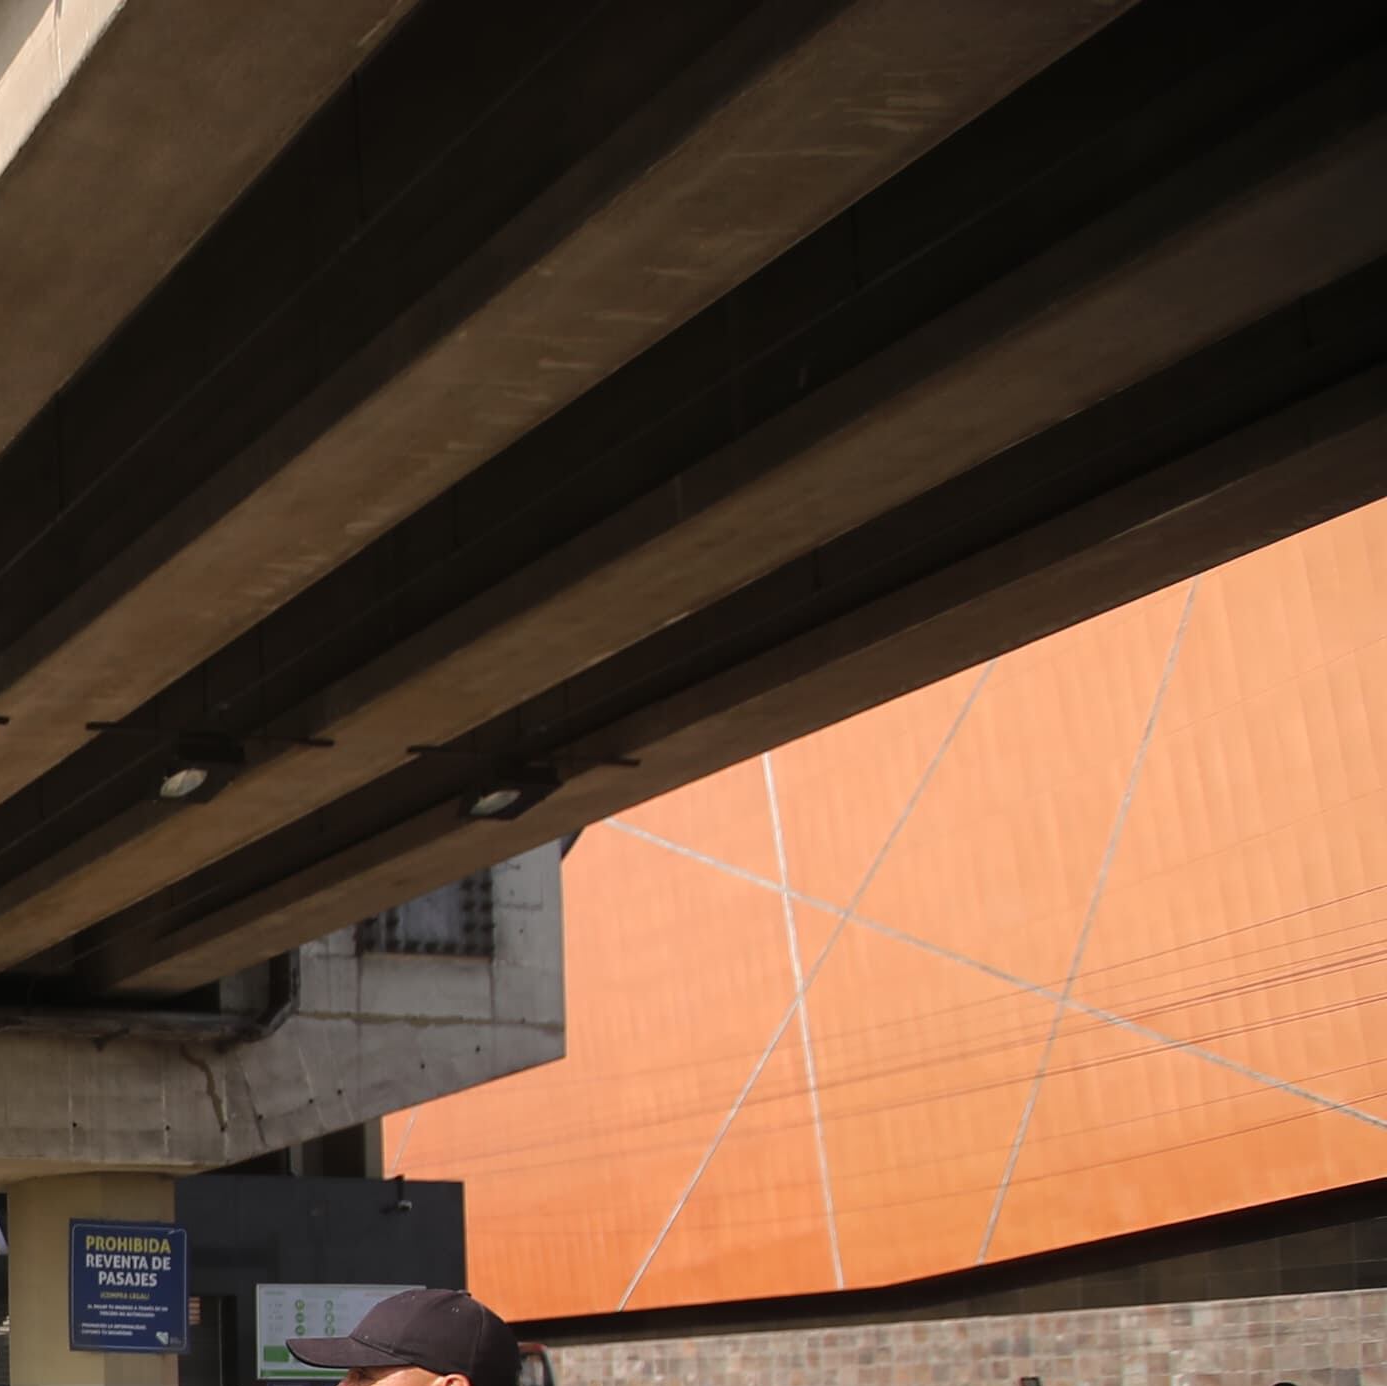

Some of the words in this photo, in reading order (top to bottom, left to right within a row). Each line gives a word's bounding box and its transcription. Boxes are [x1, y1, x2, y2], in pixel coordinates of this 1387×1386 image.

[86, 1235, 171, 1254] PROHIBIDA
[86, 1254, 148, 1270] REVENTA
[152, 1256, 171, 1271] DE
[98, 1271, 157, 1287] PASAJES
